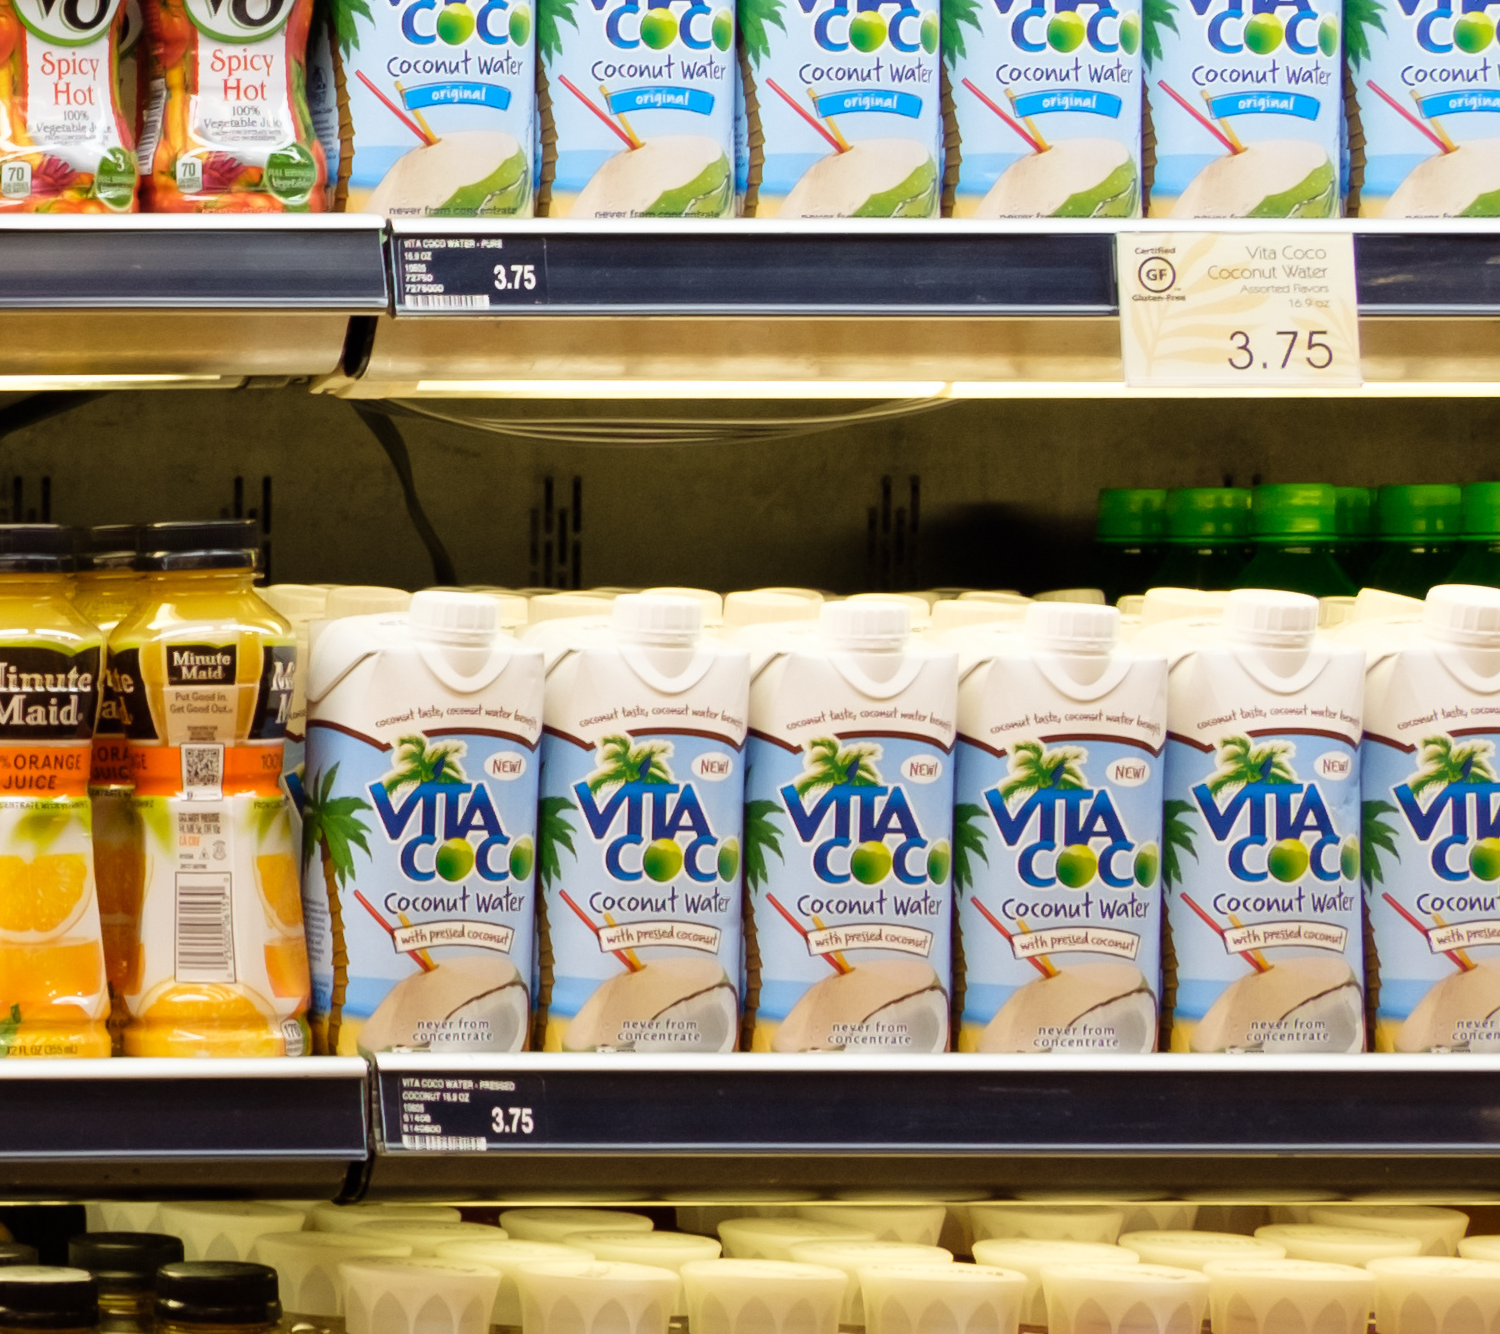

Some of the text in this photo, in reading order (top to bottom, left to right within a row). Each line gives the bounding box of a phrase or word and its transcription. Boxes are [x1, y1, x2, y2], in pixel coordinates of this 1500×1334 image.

[432, 85, 486, 106] original
[1135, 246, 1177, 255] Certified
[1246, 246, 1327, 260] Vita Coco
[493, 265, 537, 291] 3.75
[1146, 268, 1168, 281] GF
[1208, 265, 1328, 280] Coconut Water
[1240, 283, 1330, 294] Assorted Flavors
[1289, 298, 1330, 309] 16.9 oz
[1228, 331, 1334, 370] 3.75
[173, 651, 232, 669] Minute
[181, 666, 226, 681] Maid
[13, 754, 82, 772] ORANGE
[492, 758, 522, 775] NEW!
[4, 774, 58, 792] JUICE
[370, 782, 502, 840] VITA
[401, 926, 510, 946] with pressed coconut
[417, 1018, 490, 1031] never from
[412, 1030, 494, 1042] concentrate
[491, 1107, 534, 1134] 3.75
